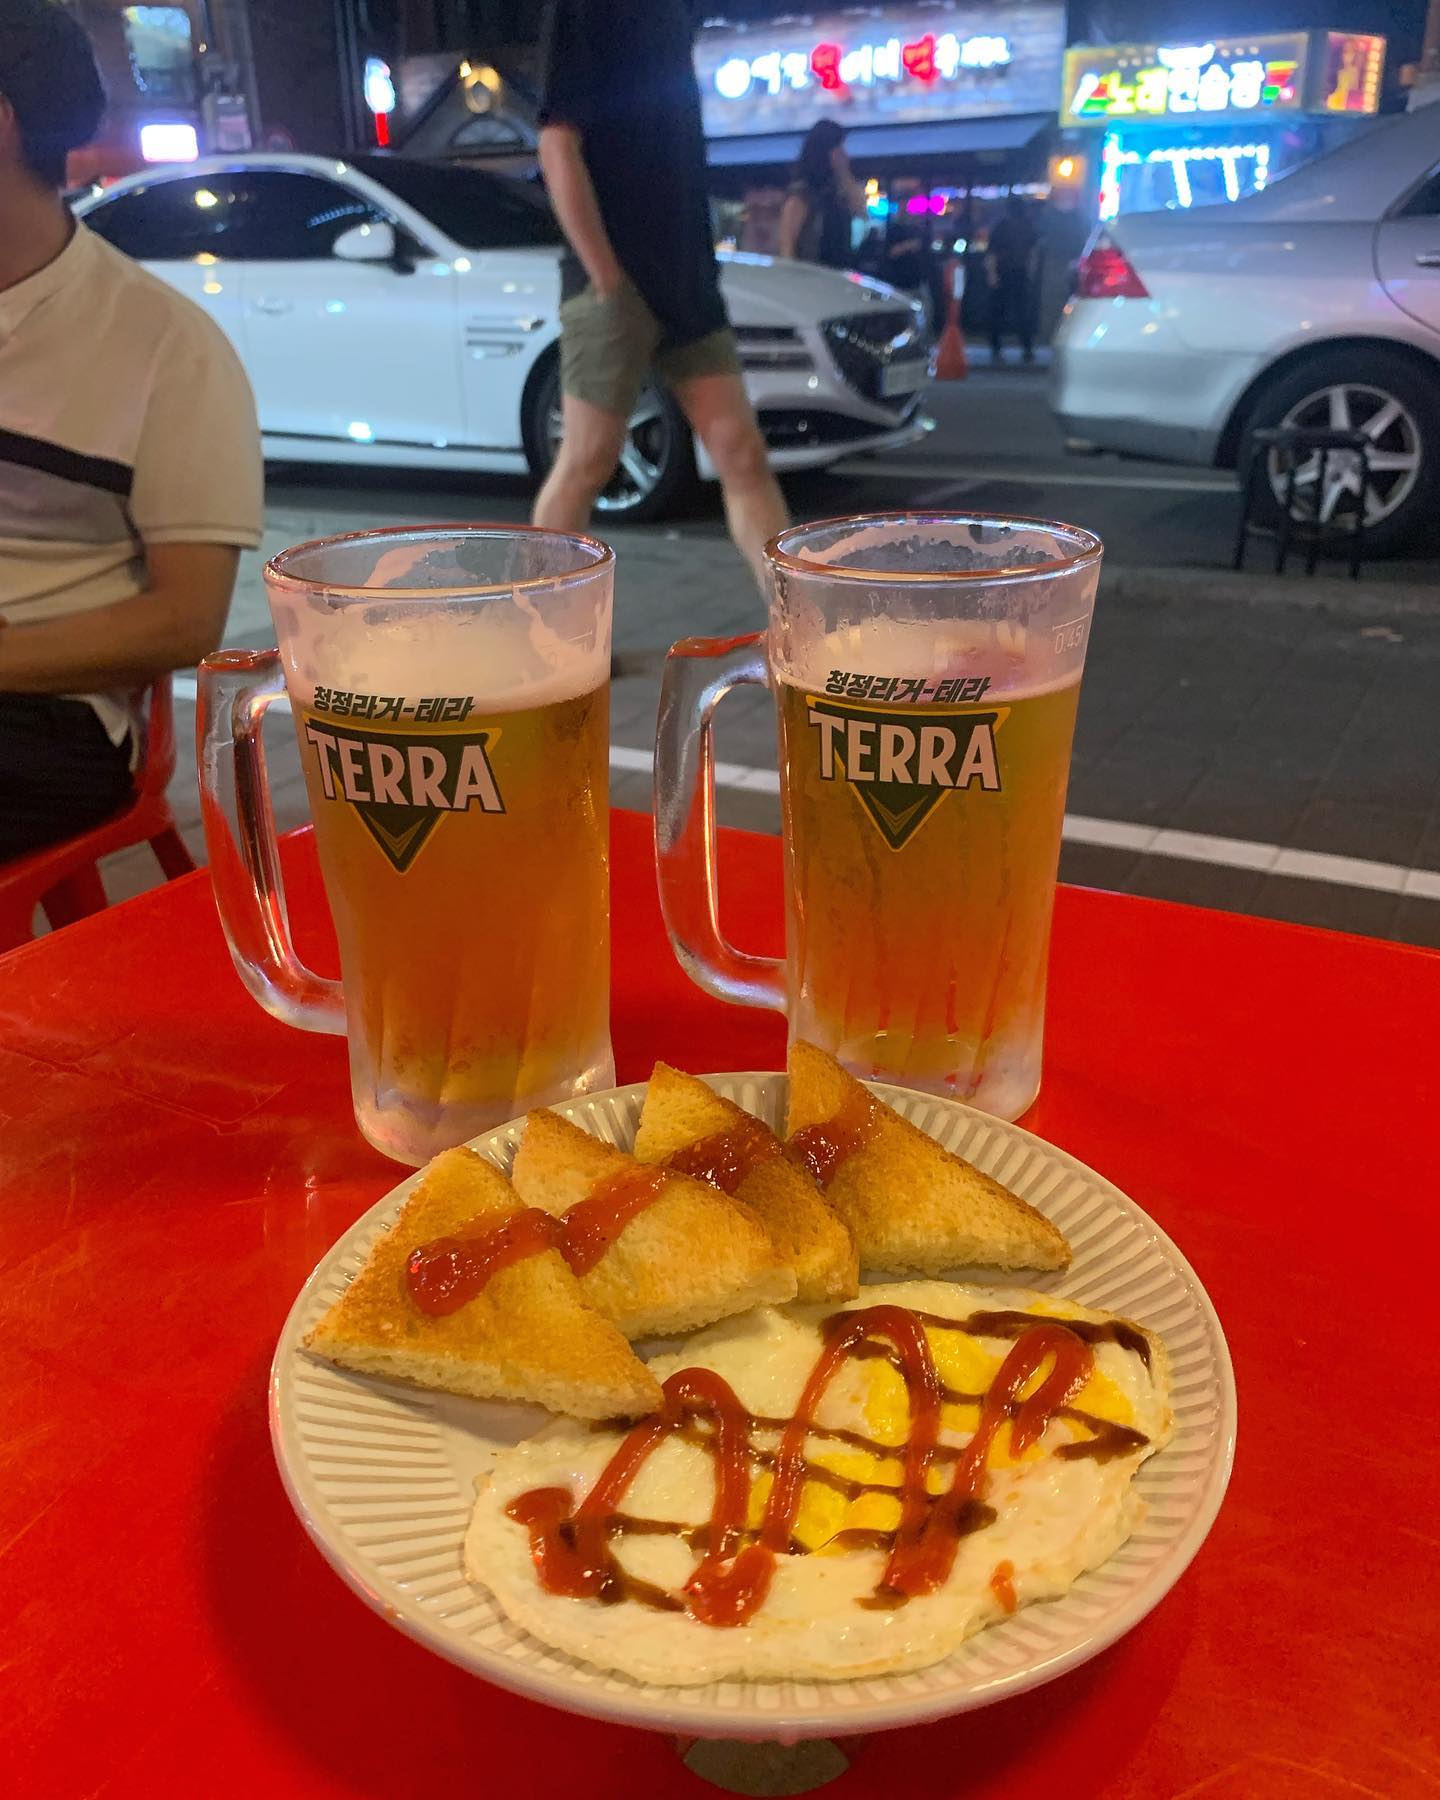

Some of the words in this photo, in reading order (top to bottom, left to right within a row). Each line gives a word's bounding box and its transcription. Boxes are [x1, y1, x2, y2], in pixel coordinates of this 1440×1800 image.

[314, 685, 475, 723] 청정라거-테라
[825, 669, 992, 703] 청정라거-테라
[305, 723, 506, 814] TERRA
[807, 706, 1001, 792] TERRA
